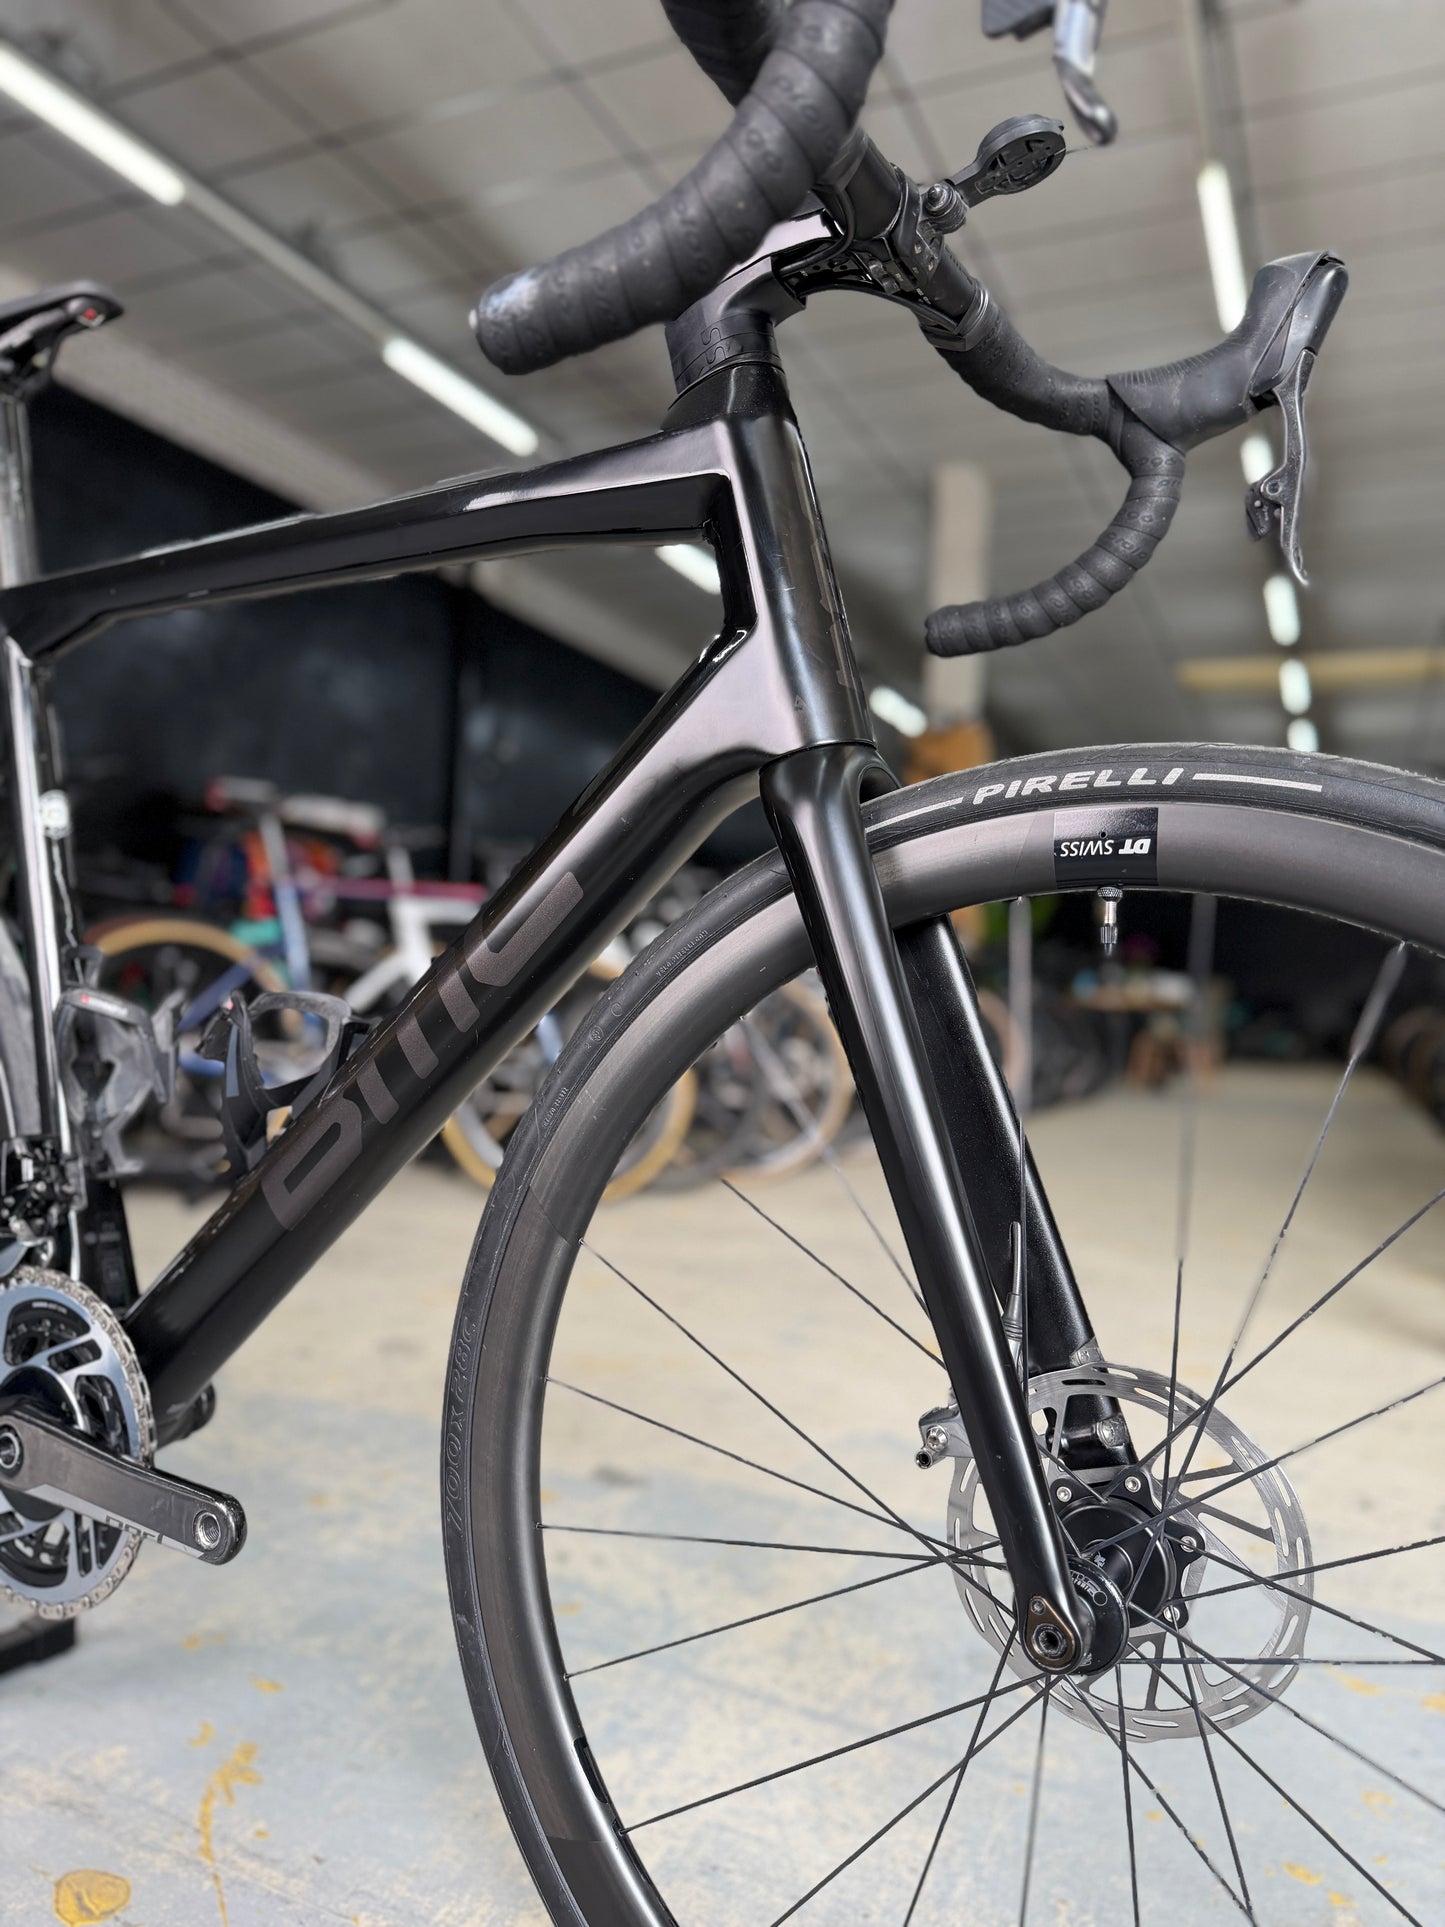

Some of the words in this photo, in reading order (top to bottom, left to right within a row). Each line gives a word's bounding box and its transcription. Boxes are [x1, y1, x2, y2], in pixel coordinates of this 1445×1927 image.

[972, 767, 1184, 805] PIRELLI
[1060, 839, 1114, 857] SWISS
[1118, 838, 1151, 855] DT
